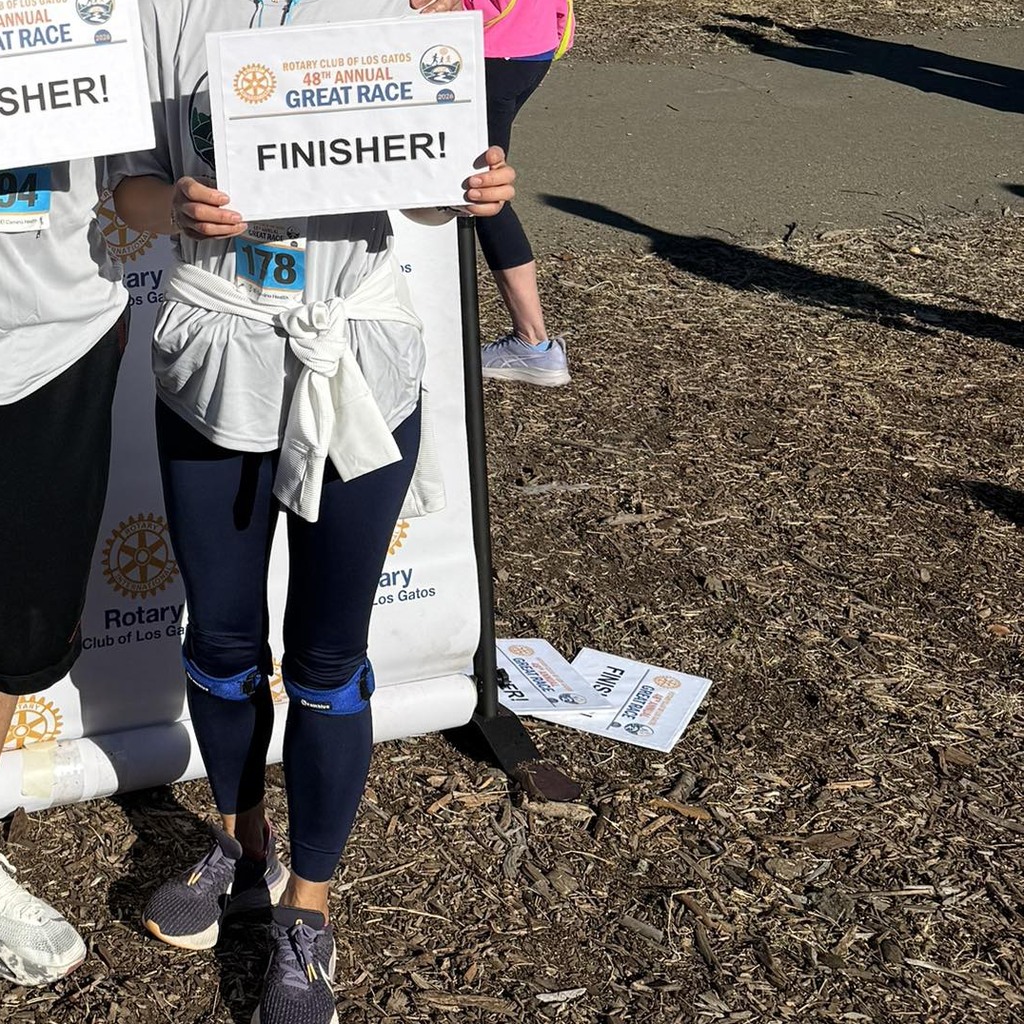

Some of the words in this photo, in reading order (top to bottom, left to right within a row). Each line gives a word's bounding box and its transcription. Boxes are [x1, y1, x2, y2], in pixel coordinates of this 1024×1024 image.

[18, 23, 72, 49] RACE
[282, 60, 318, 71] ROTARY
[320, 58, 344, 69] CLUB
[347, 57, 359, 66] OF
[361, 55, 379, 65] LOS
[381, 52, 412, 64] GATOS
[303, 71, 331, 86] 48TH
[334, 67, 393, 84] ANNUAL
[285, 85, 352, 109] GREAT
[357, 81, 413, 103] RACE
[257, 131, 447, 171] FINISHER!
[241, 244, 296, 285] 178
[123, 269, 163, 289] ary
[379, 568, 413, 588] ary
[398, 587, 436, 602] Gatos
[105, 604, 184, 629] Rotary
[82, 637, 114, 650] Club
[118, 632, 133, 644] of
[137, 629, 161, 642] Los
[593, 666, 625, 696] FINIS
